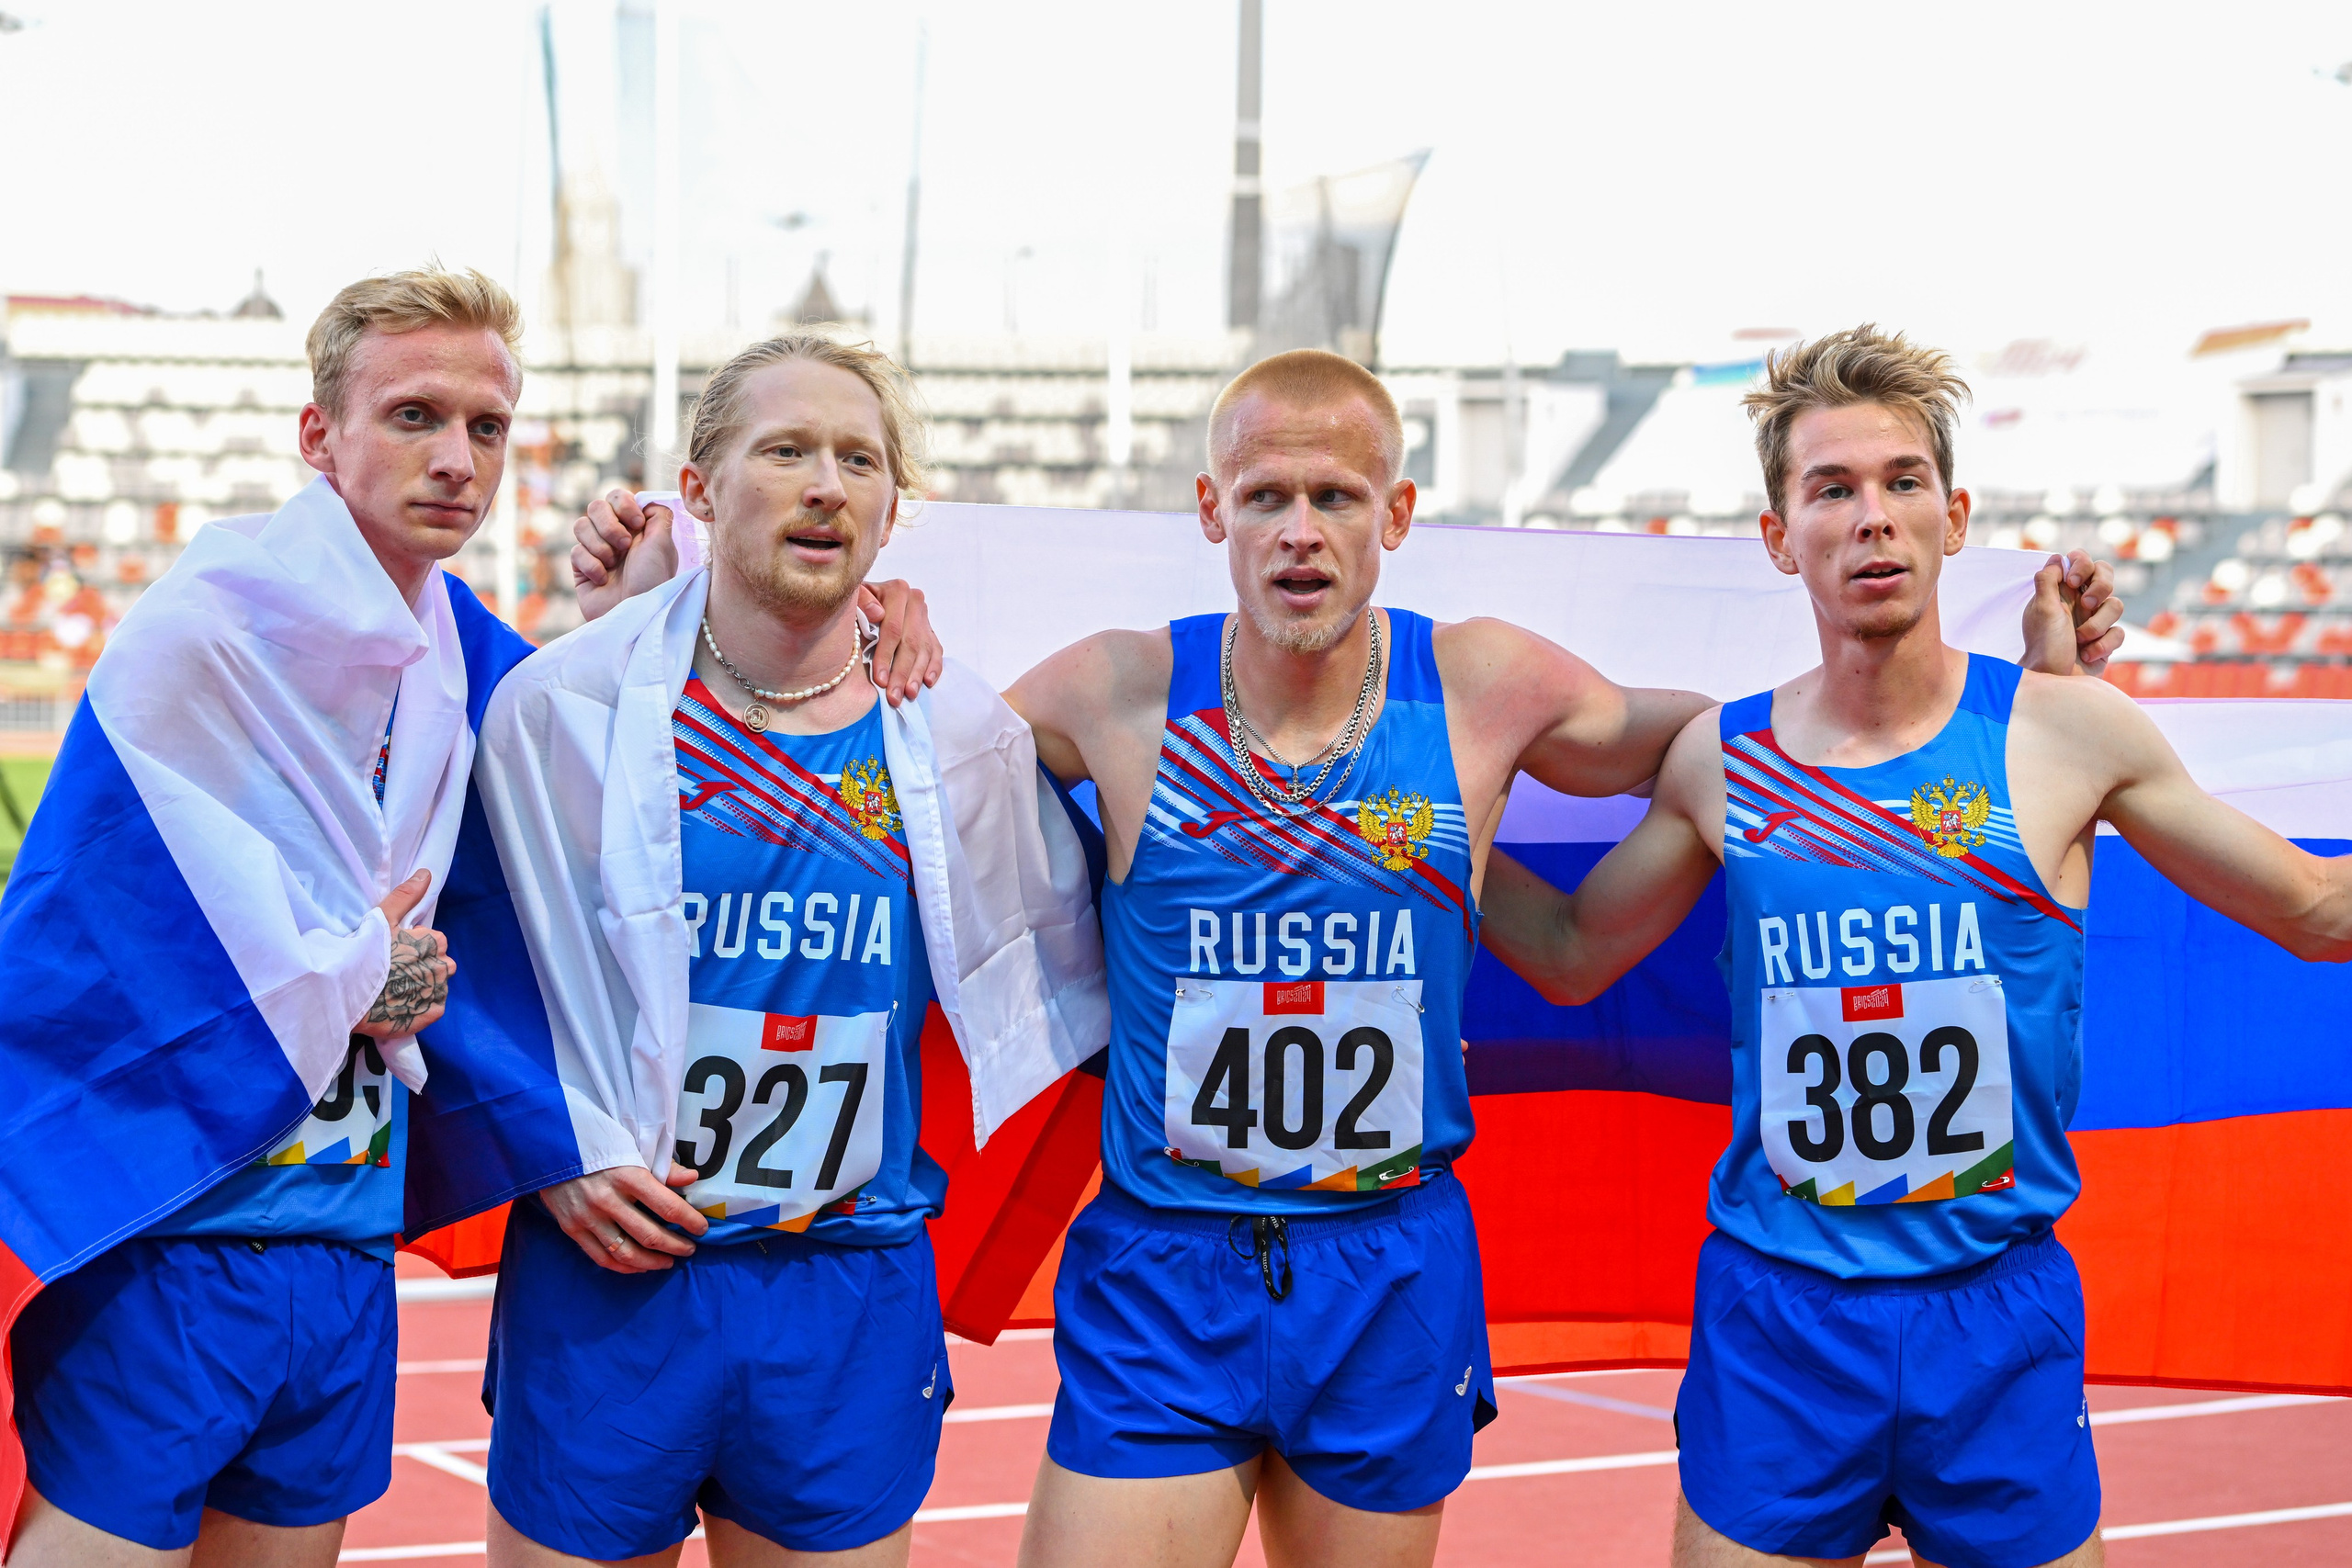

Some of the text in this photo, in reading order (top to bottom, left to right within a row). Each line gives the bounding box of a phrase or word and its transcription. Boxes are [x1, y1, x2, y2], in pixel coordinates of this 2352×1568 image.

[681, 891, 891, 965] RUSSIA
[1190, 908, 1416, 976] RUSSIA
[1758, 902, 1986, 985] RUSSIA
[675, 1055, 869, 1190] 327
[1192, 1025, 1395, 1150] 402
[1786, 1025, 1984, 1163] 382
